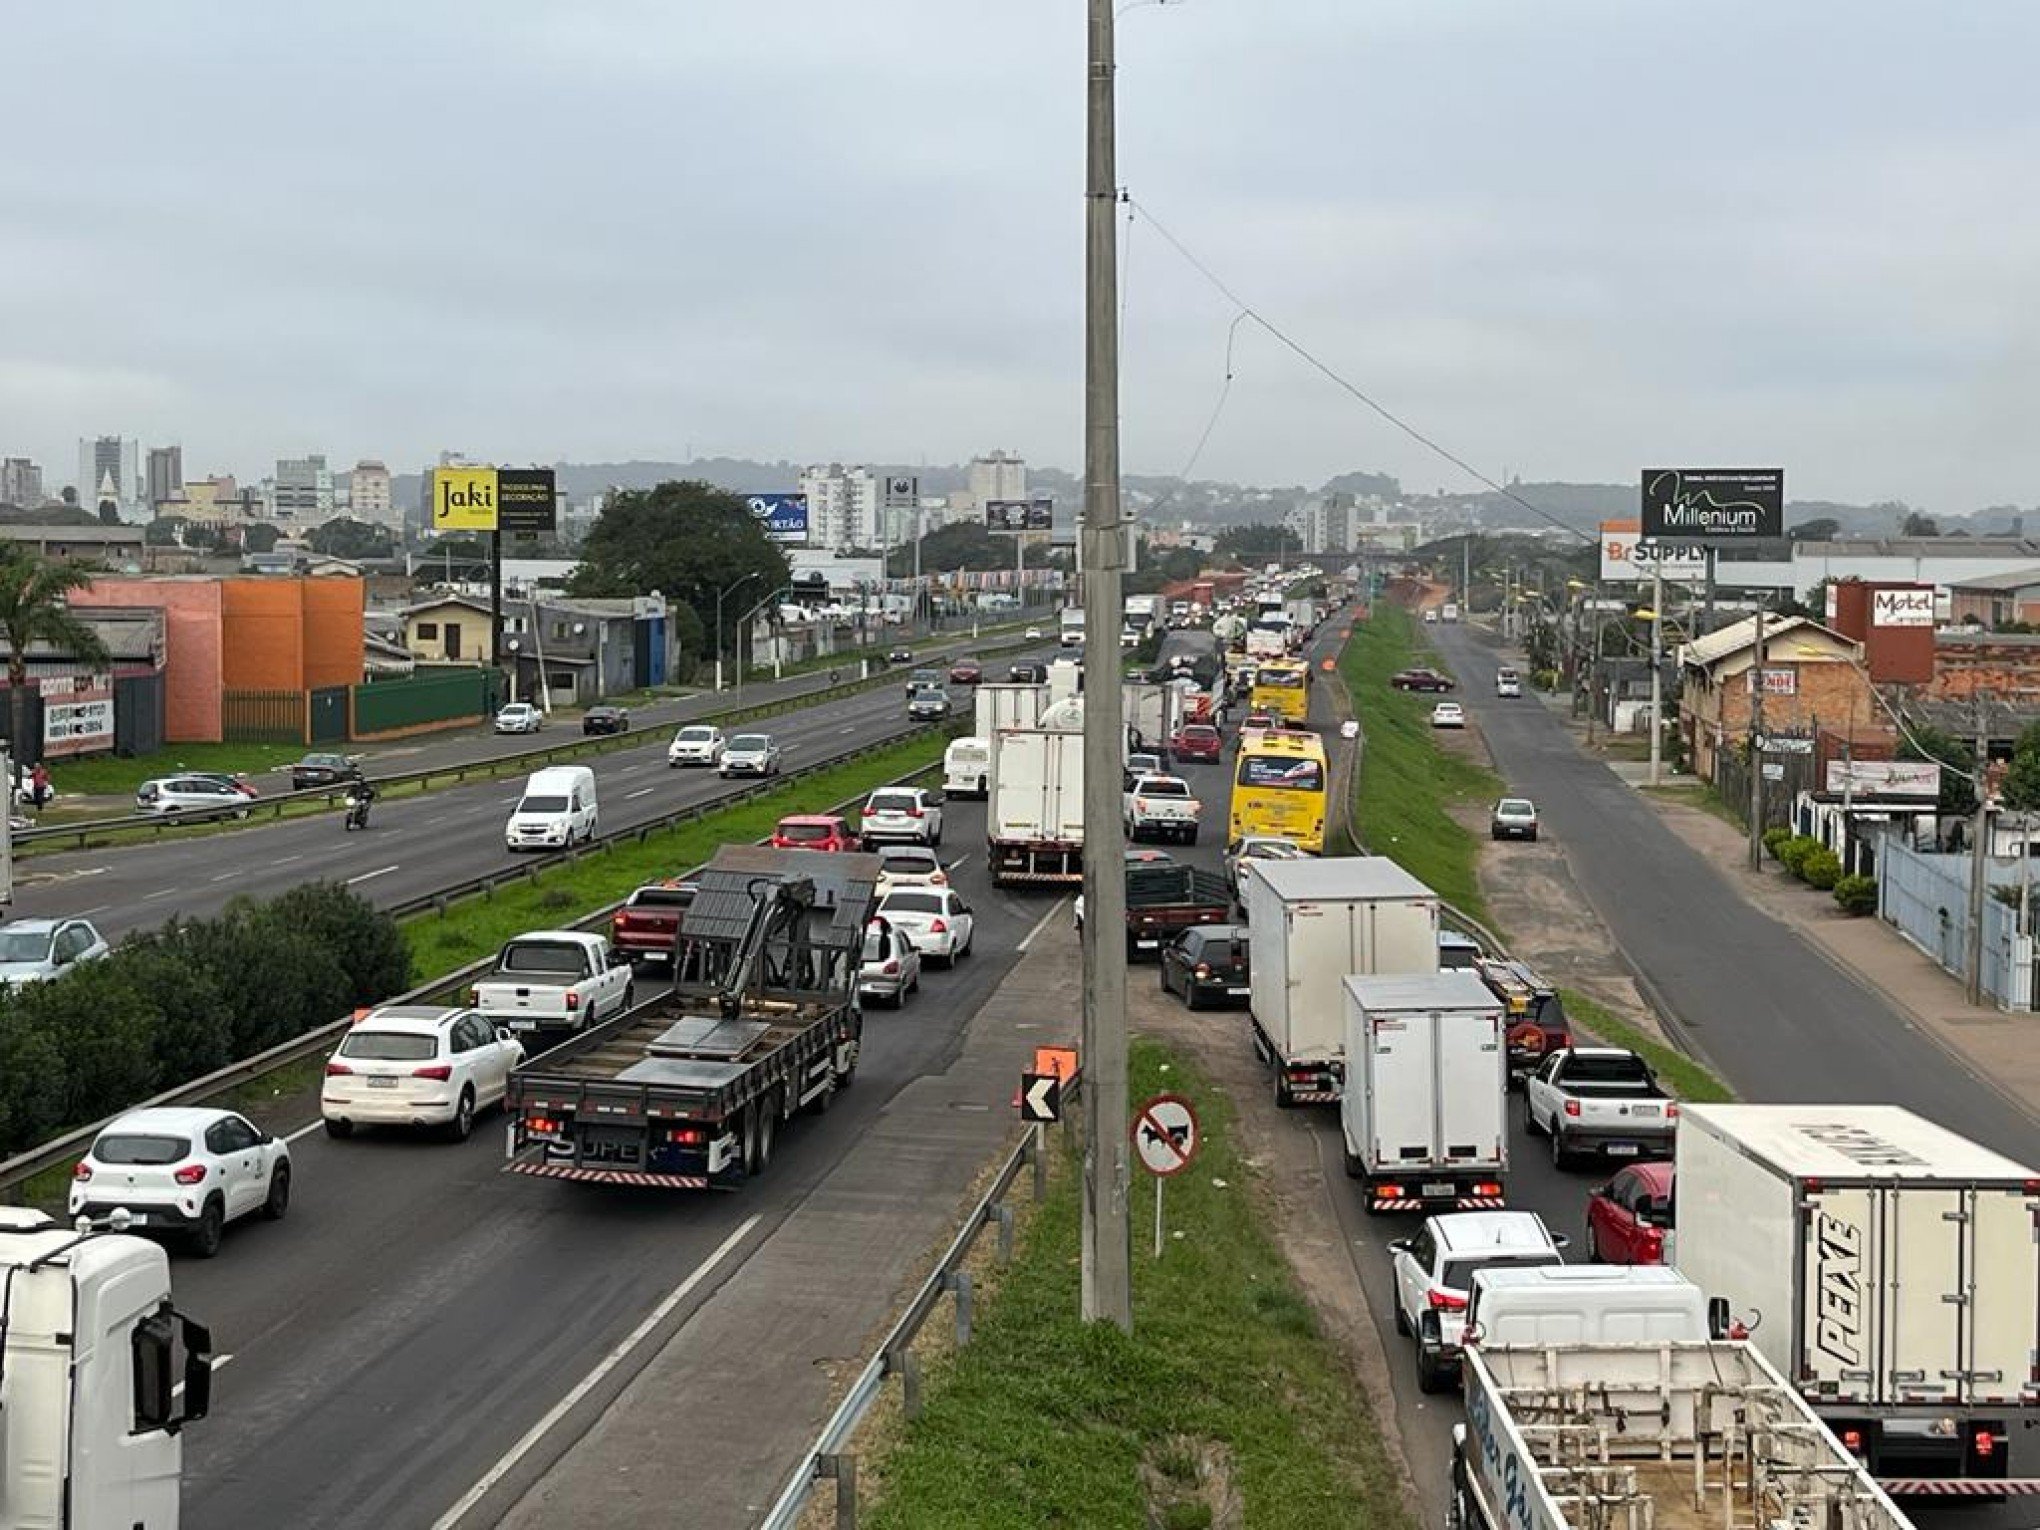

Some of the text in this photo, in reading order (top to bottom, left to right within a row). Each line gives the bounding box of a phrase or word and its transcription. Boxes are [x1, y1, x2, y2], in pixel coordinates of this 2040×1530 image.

[438, 481, 493, 519] Jaki
[1663, 503, 1756, 525] Millenium
[1608, 541, 1706, 561] Br SUPPLY
[1876, 593, 1932, 615] Motel
[1817, 1212, 1862, 1366] PEIXE
